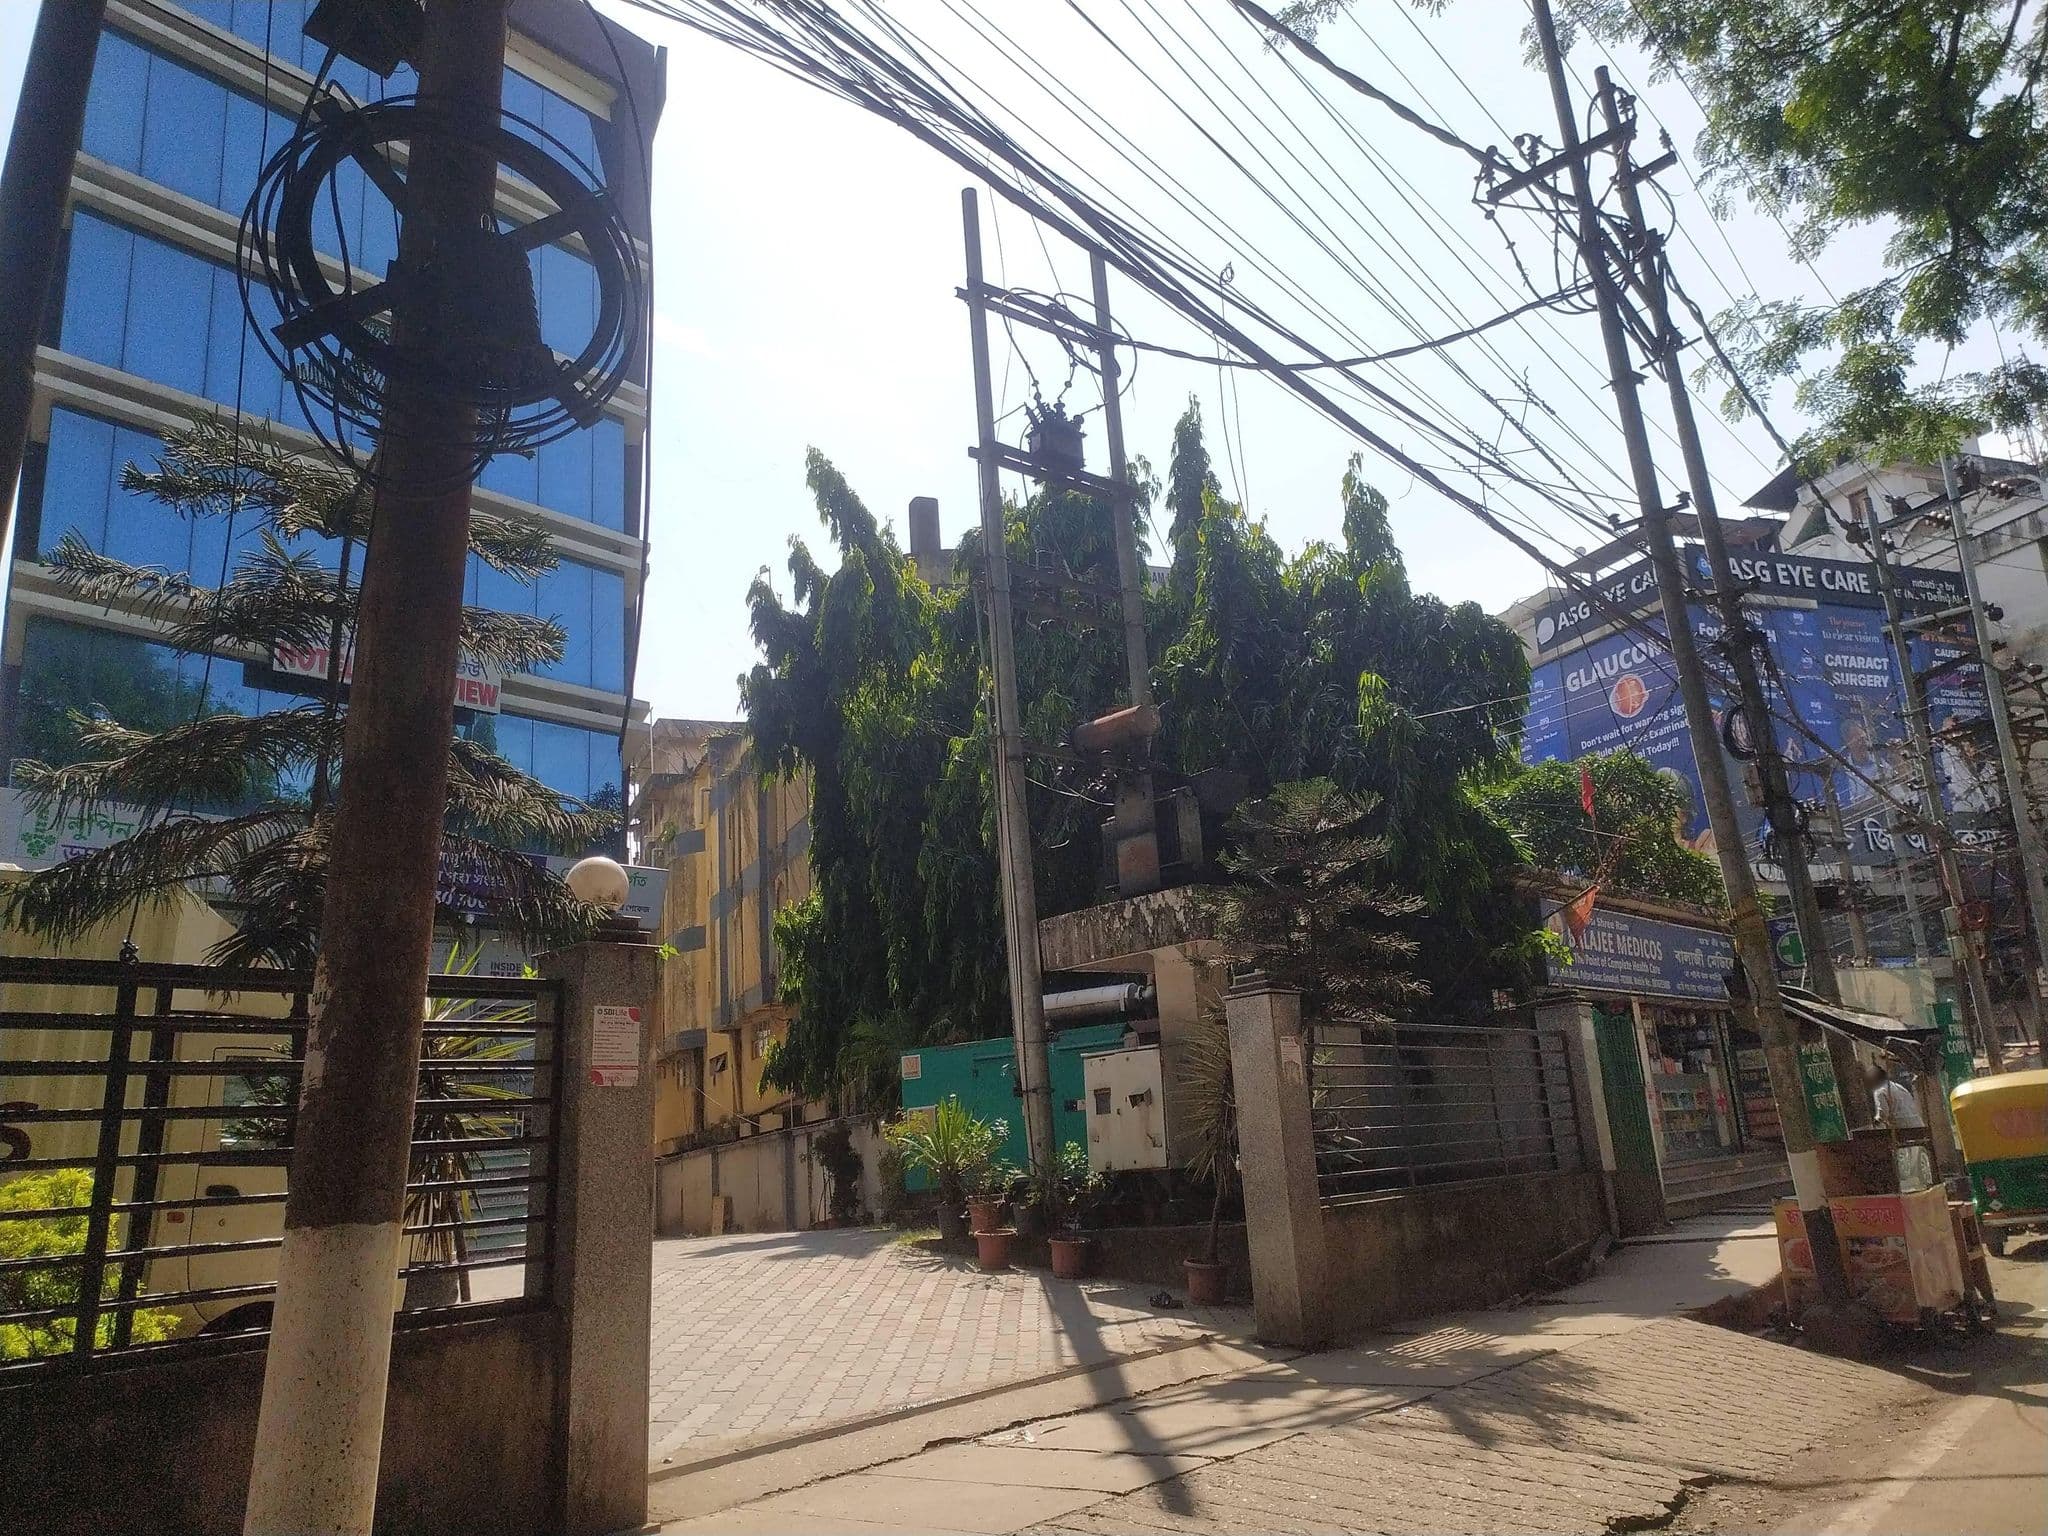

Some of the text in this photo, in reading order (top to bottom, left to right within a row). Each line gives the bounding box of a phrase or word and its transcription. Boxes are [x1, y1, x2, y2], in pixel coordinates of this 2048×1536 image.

[1729, 557, 1871, 594] ASG EYE CARE
[1558, 601, 1590, 631] ASG
[1824, 653, 1889, 670] CATARACT
[1934, 648, 1960, 659] CAUSE
[1833, 671, 1889, 688] SURGERY
[1581, 736, 1602, 750] Don't
[1602, 729, 1621, 743] wait
[1621, 723, 1634, 735] for
[1647, 736, 1681, 756] Today!!!
[1568, 926, 1615, 955] BLAJEE
[1616, 934, 1663, 962] MEDICOS
[490, 961, 522, 972] INSIDE
